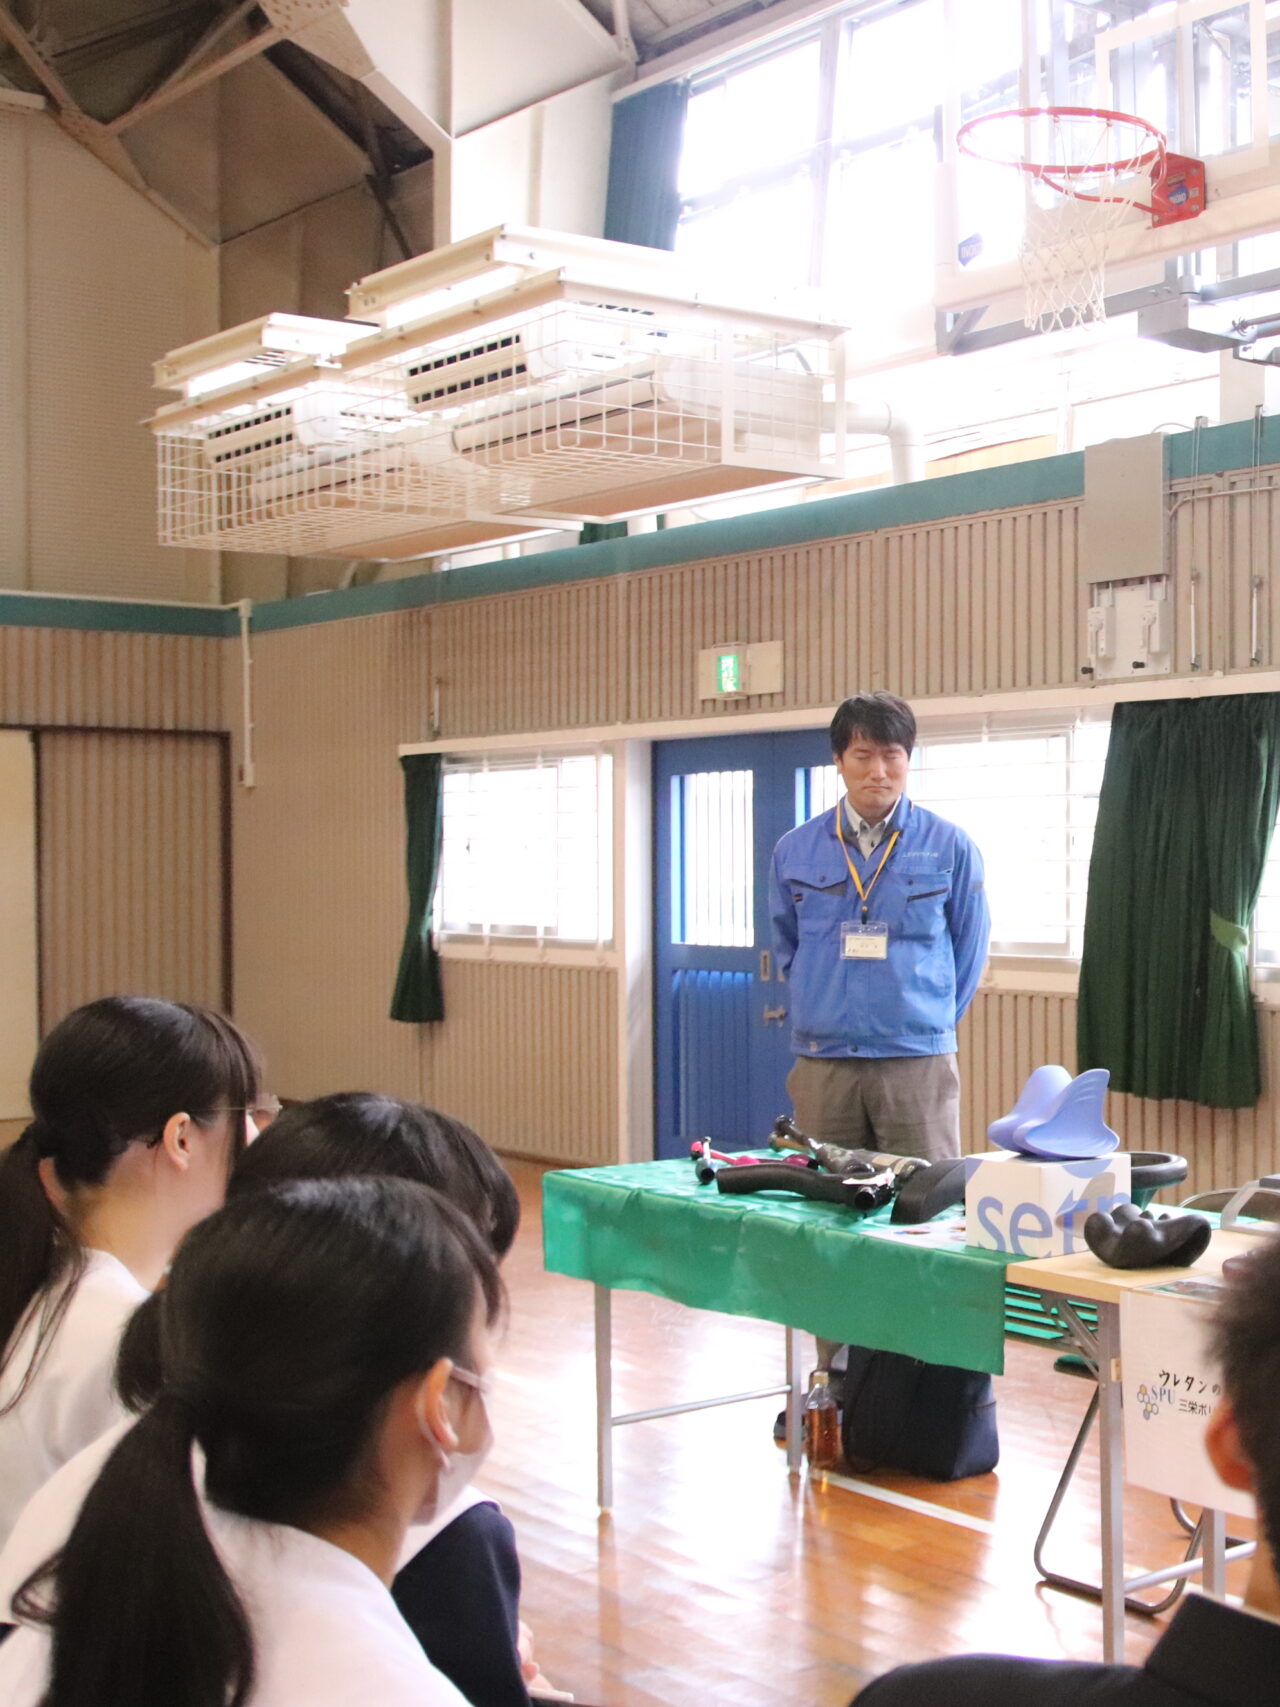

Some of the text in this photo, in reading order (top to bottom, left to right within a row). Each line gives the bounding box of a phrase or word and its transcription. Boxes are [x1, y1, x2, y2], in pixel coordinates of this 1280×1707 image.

[1159, 1369, 1222, 1396] ウレタンの
[1151, 1386, 1176, 1405] SPU
